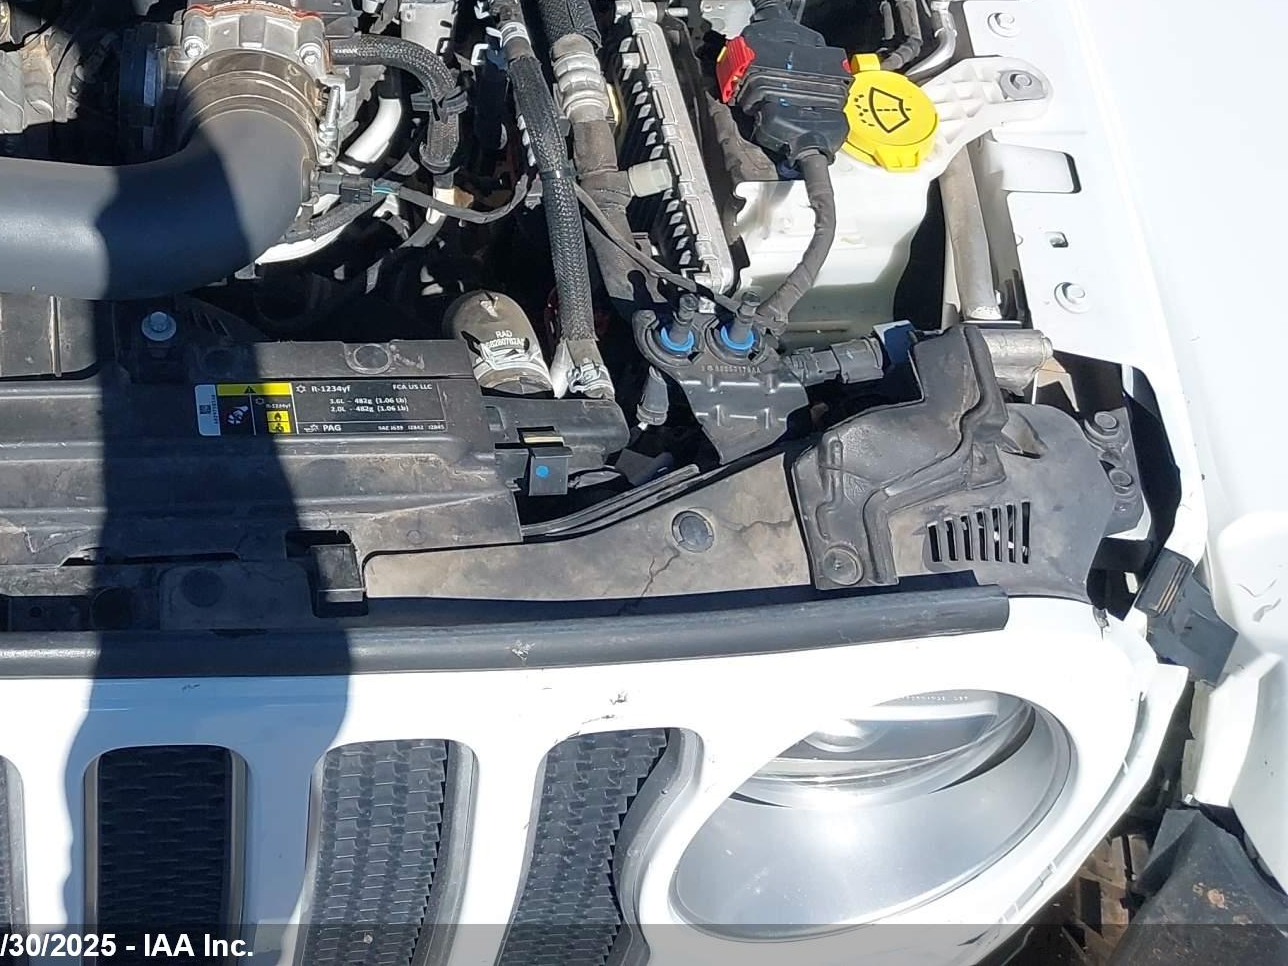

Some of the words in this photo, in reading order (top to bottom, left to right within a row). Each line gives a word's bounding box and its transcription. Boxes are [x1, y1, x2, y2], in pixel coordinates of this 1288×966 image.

[495, 330, 513, 338] RAD
[311, 385, 351, 394] R-1234yf
[322, 424, 342, 432] PAG
